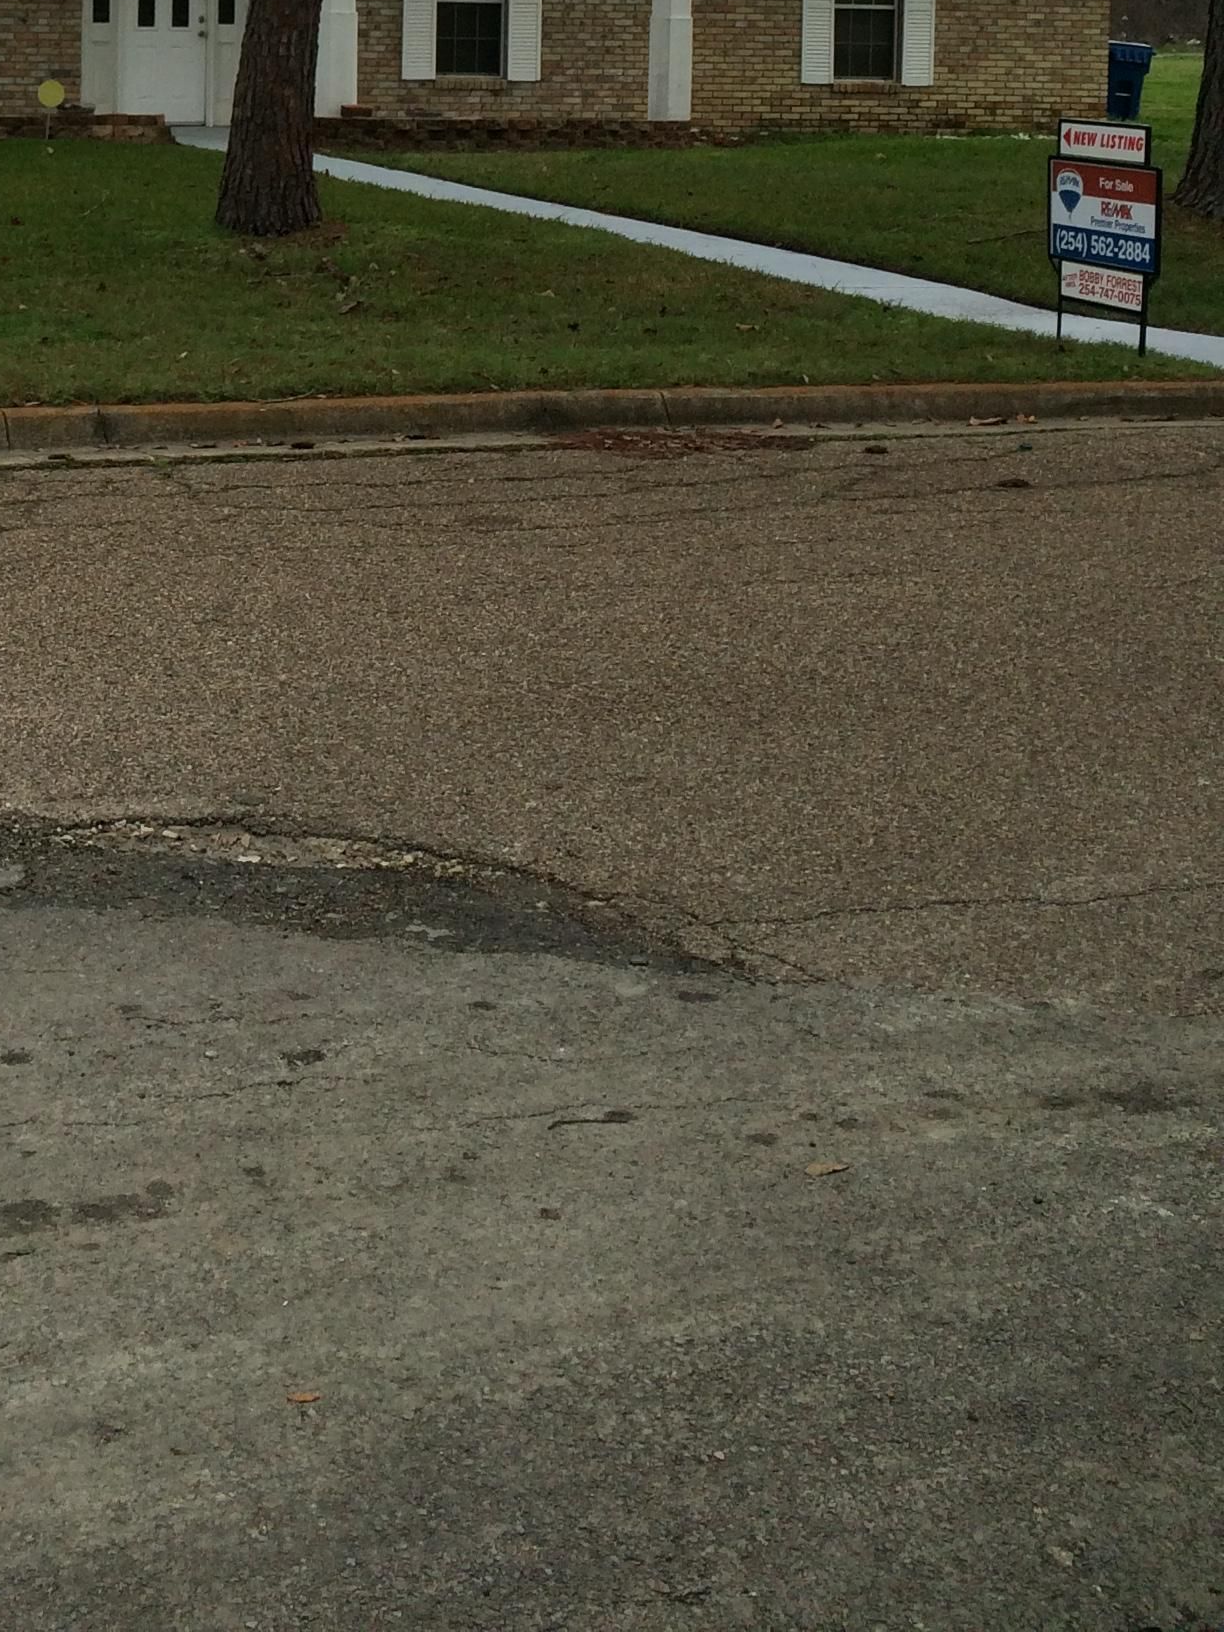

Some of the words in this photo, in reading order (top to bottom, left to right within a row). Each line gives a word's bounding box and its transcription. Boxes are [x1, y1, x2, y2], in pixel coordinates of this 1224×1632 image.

[1073, 130, 1098, 147] NEW
[1100, 133, 1144, 151] LISTING
[1099, 176, 1113, 189] For
[1115, 179, 1134, 192] Sale
[1100, 201, 1133, 220] RE/MAX
[1091, 216, 1114, 229] Premier
[1115, 220, 1145, 234] Properties
[1056, 228, 1087, 257] (254)
[1091, 235, 1150, 264] 562-2884
[1079, 269, 1104, 285] BOBBY
[1107, 275, 1142, 292] FORREST
[1079, 283, 1141, 306] 254-747-0075
